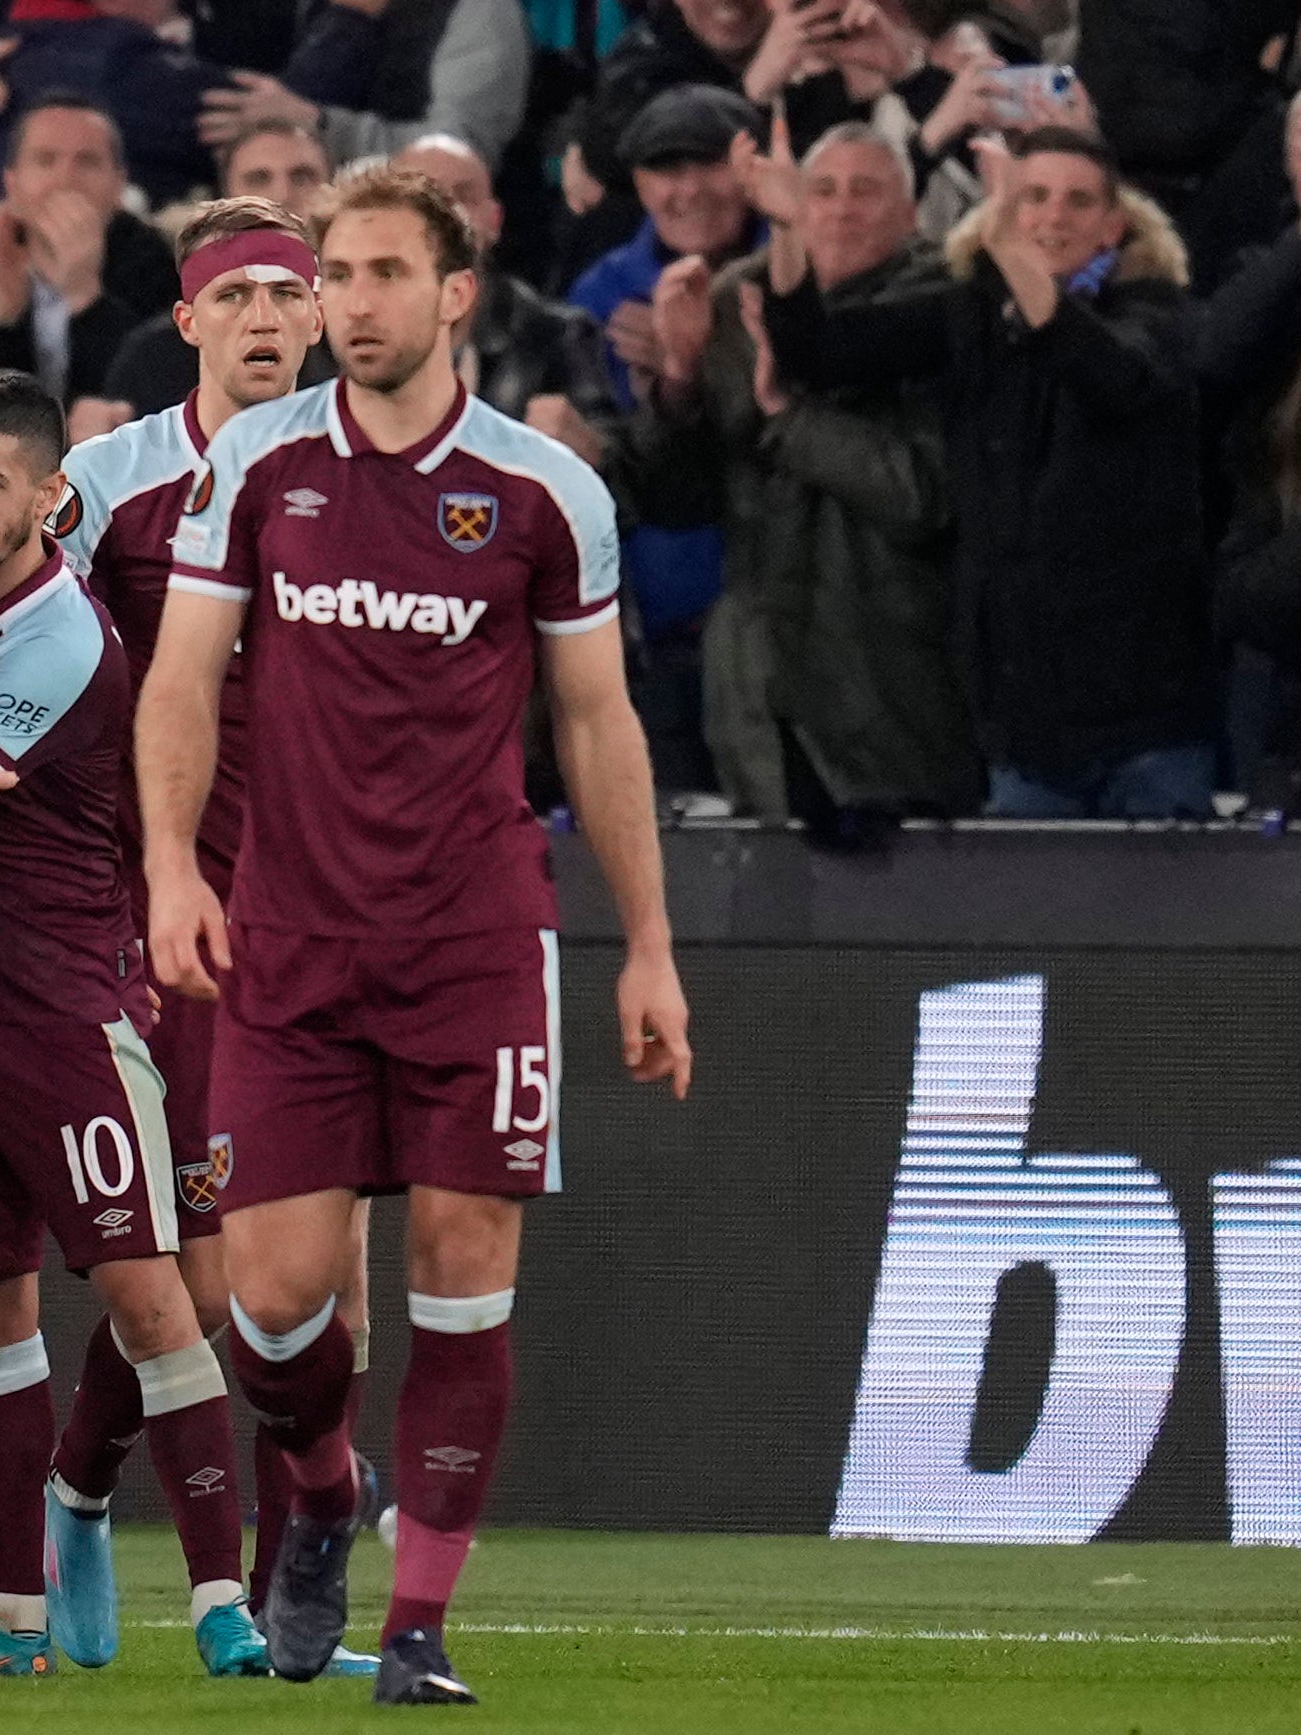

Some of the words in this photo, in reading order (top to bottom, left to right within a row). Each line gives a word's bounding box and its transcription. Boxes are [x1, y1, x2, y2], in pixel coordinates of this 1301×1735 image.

[272, 571, 488, 646] betway
[492, 1045, 549, 1133] 15
[60, 1115, 134, 1204] 10
[102, 1225, 132, 1239] umbro
[830, 974, 1301, 1546] b
